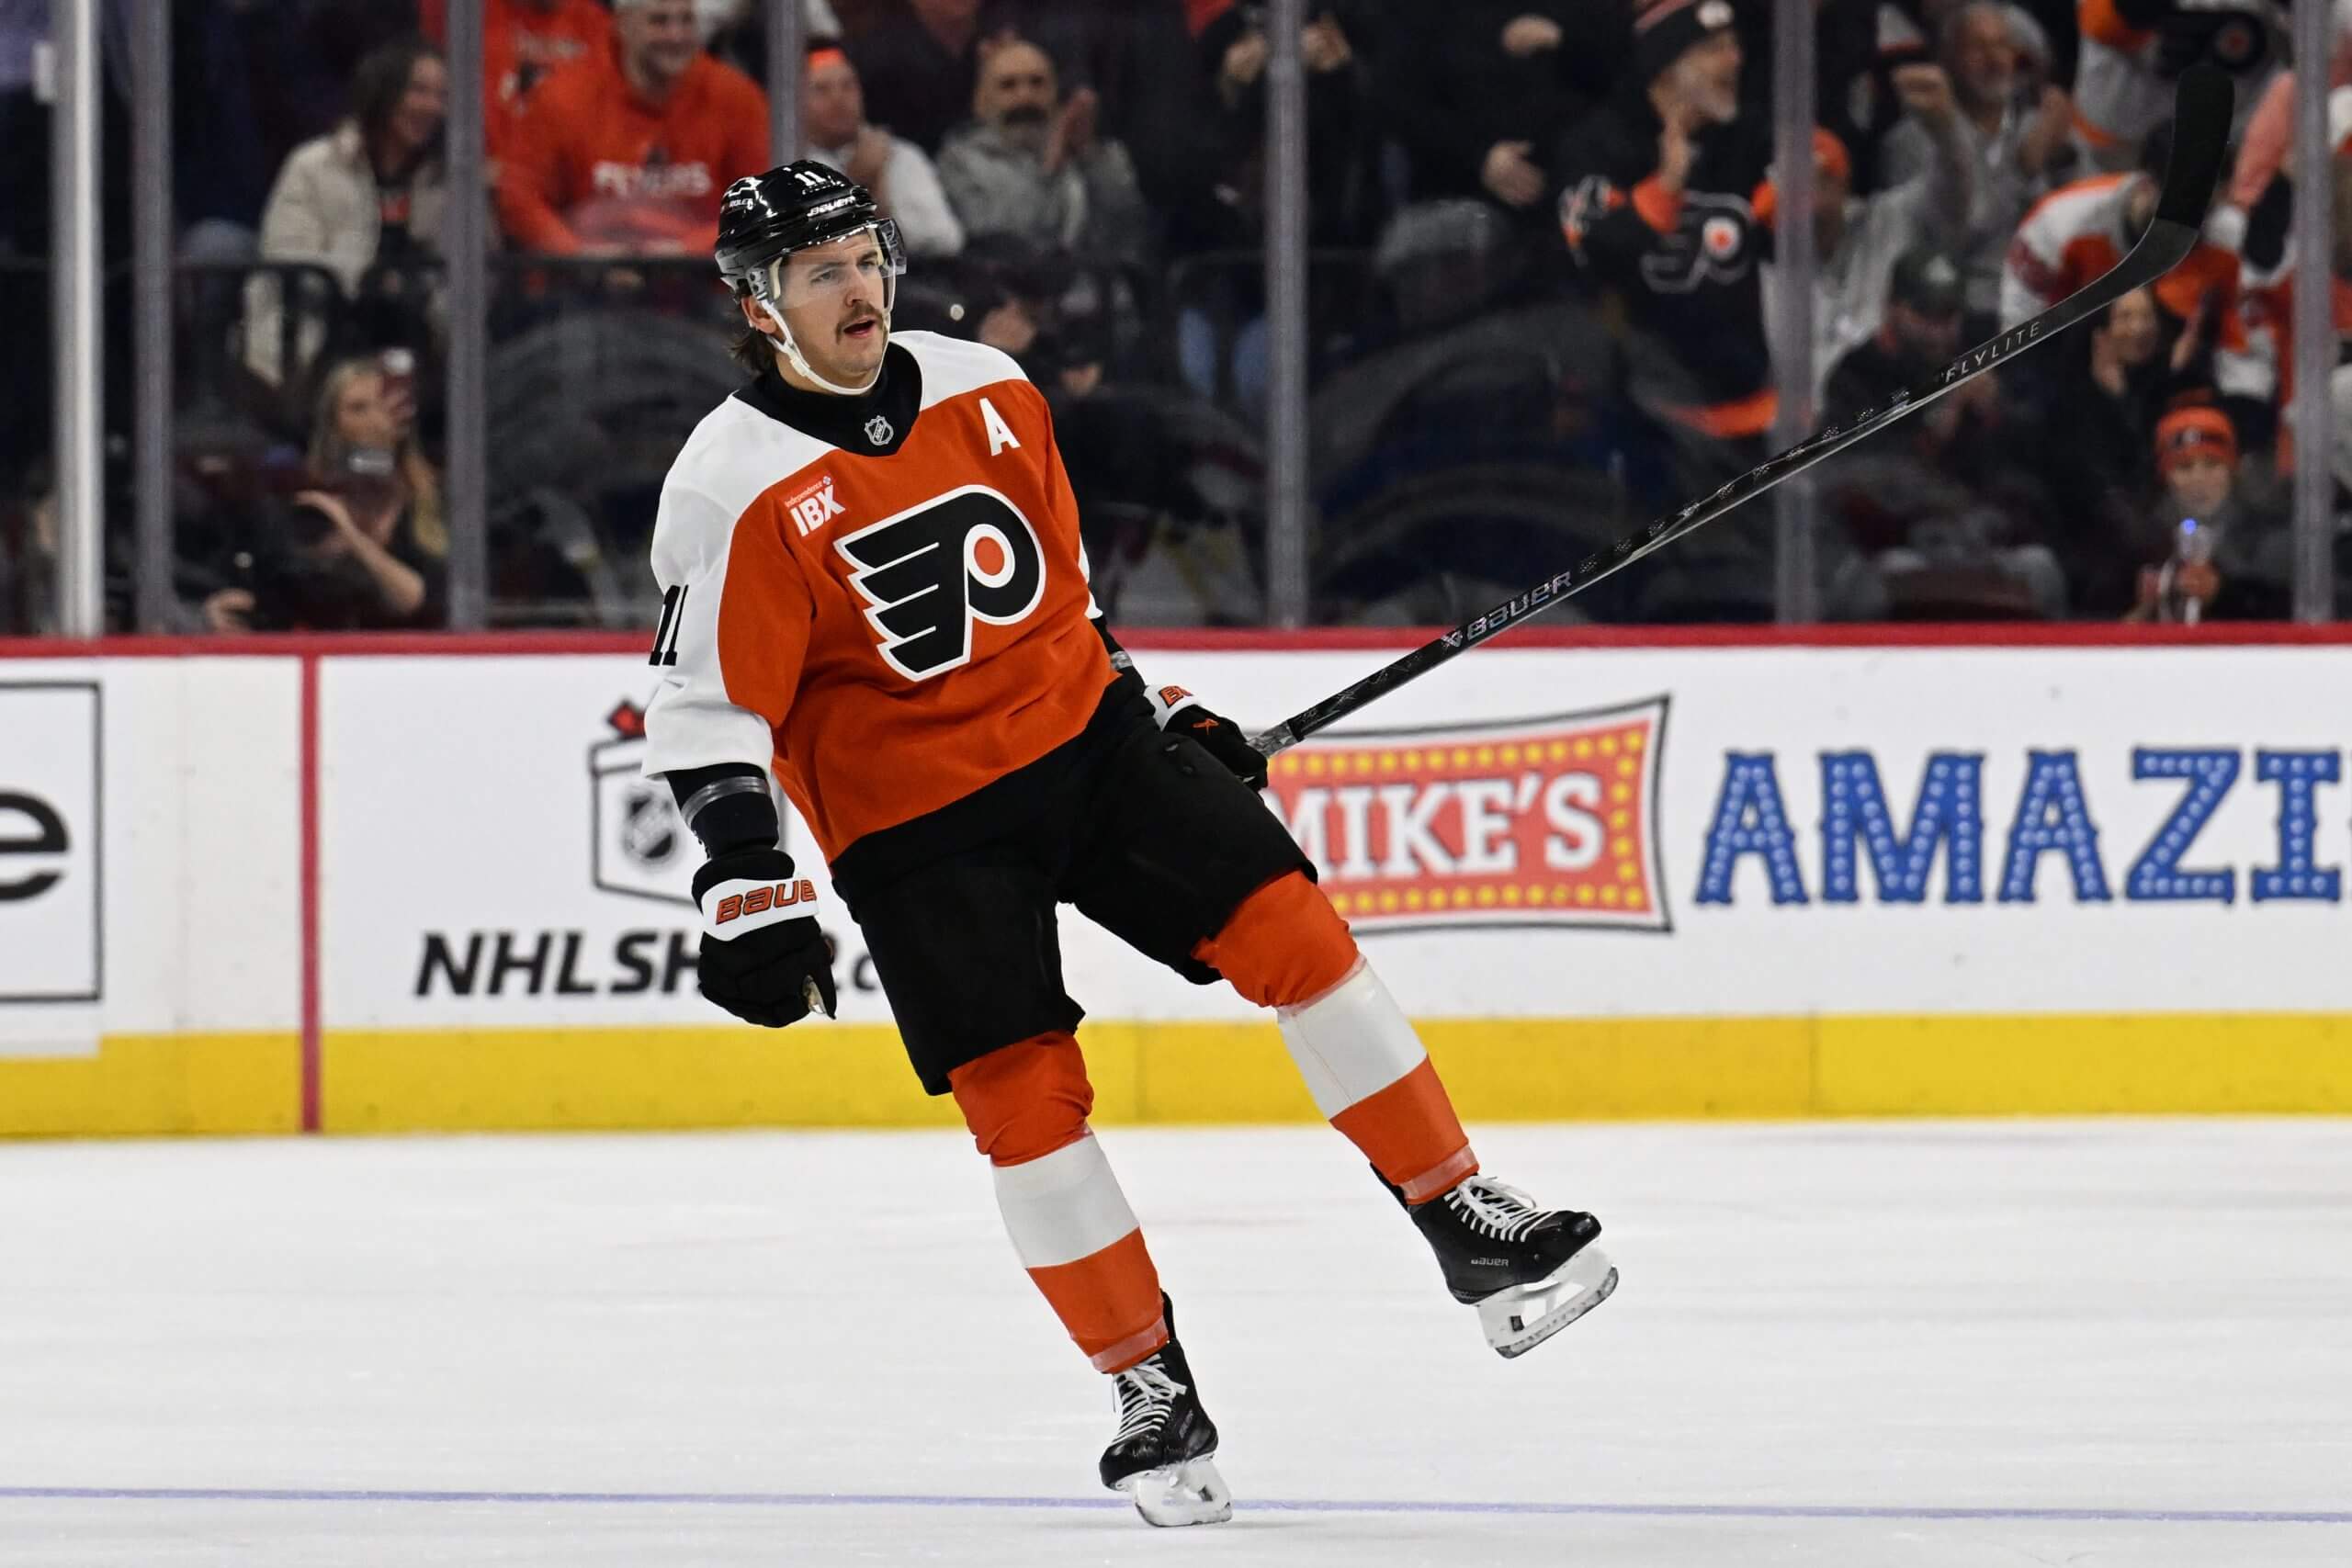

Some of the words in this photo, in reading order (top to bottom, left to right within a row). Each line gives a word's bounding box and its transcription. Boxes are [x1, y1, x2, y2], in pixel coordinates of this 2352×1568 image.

[795, 170, 827, 186] 11
[1945, 321, 2040, 382] FLYLITE
[978, 397, 1022, 457] A
[790, 484, 846, 537] IBX
[649, 583, 689, 666] 11
[1467, 571, 1572, 640] BAUER
[1258, 770, 1605, 882] MIKE'S
[1695, 745, 2352, 905] AMAZI
[716, 879, 818, 926] BAUE
